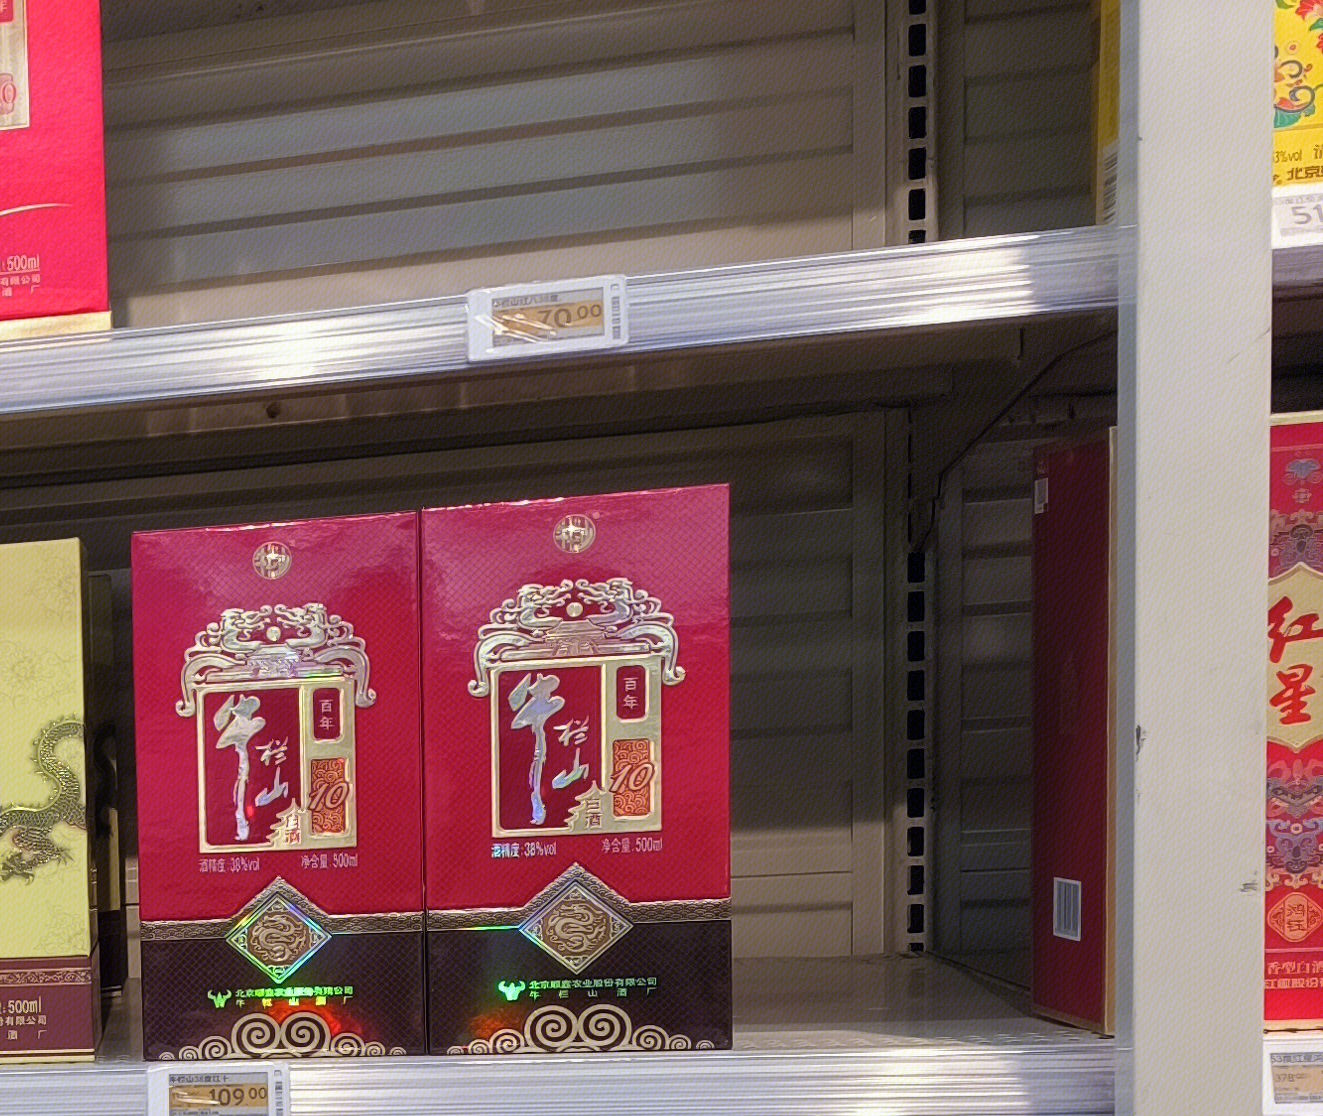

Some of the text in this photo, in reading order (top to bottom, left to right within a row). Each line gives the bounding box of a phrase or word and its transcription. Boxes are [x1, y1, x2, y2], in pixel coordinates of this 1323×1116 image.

[623, 677, 638, 709] 百年
[1267, 596, 1323, 725] 红星
[319, 699, 335, 731] 百年
[509, 673, 589, 826] 牛栏山
[213, 694, 288, 842] 牛栏山
[610, 763, 655, 792] 10
